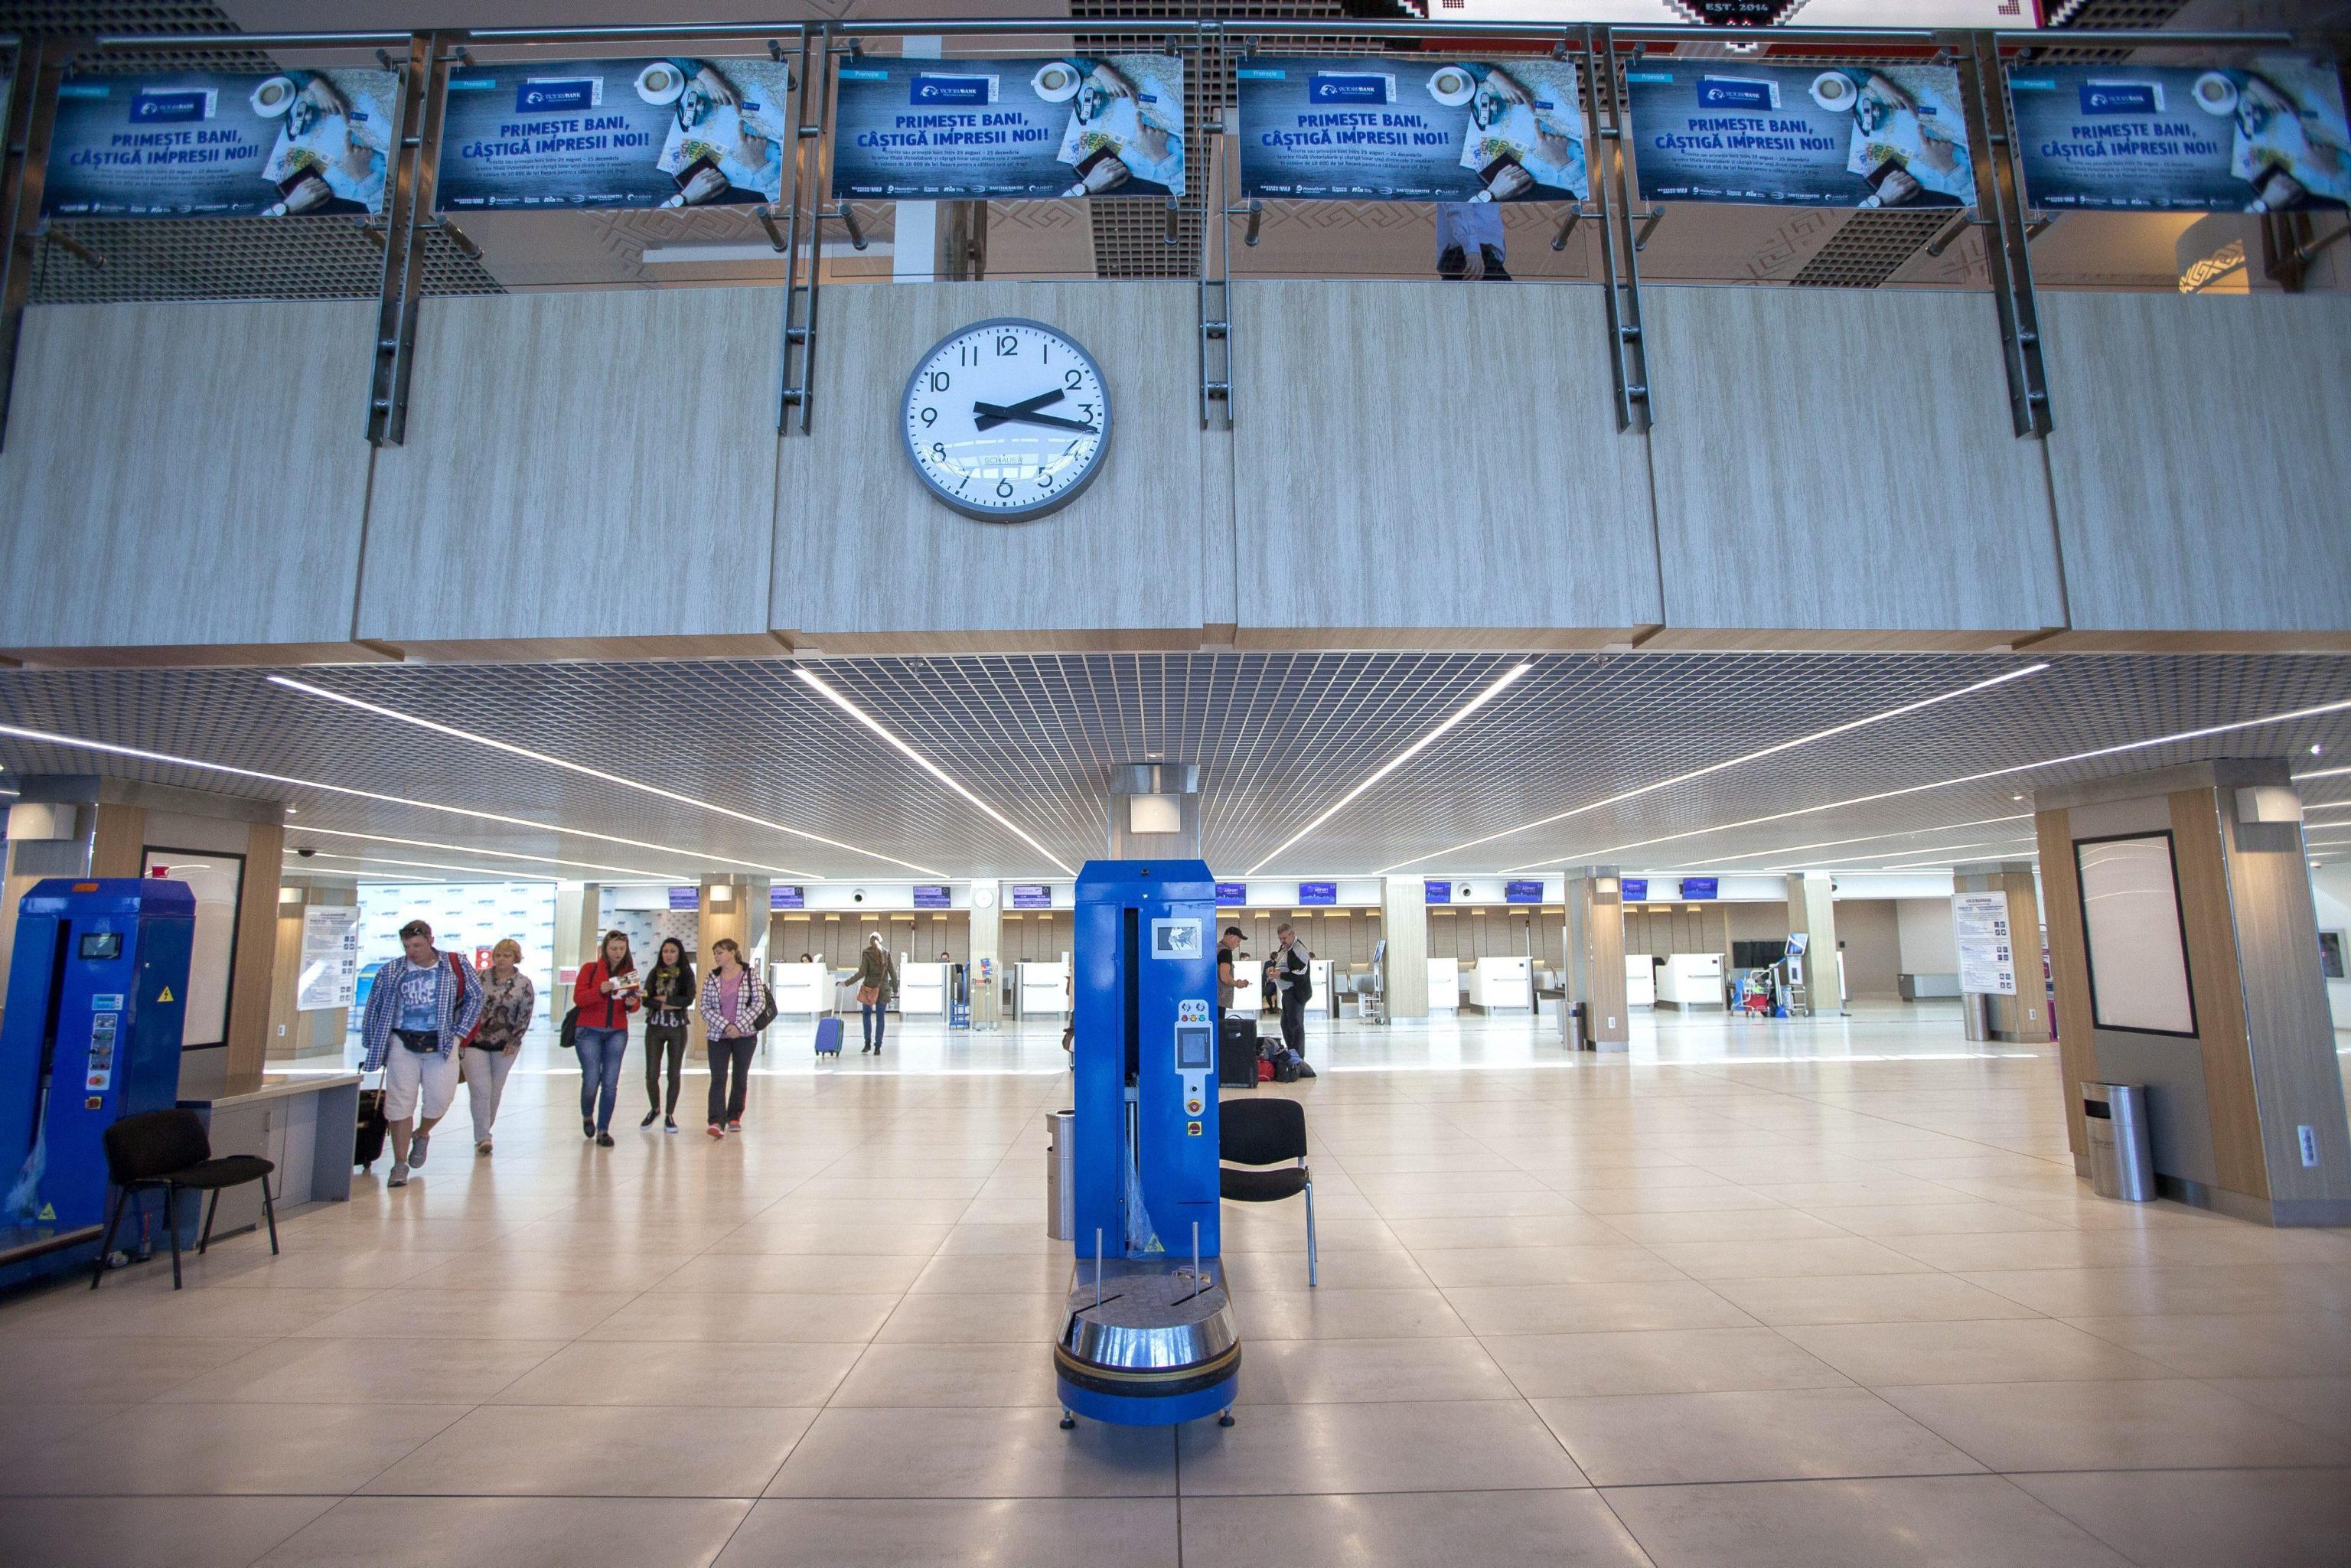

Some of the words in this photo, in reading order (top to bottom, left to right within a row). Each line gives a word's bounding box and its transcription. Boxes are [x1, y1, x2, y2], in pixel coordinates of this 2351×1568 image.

[1705, 3, 1735, 11] EST.
[584, 116, 630, 131] BANI,
[983, 112, 1029, 127] BANI,
[1383, 114, 1427, 129] BANI,
[1769, 120, 1812, 135] BANI,
[536, 136, 607, 153] IMPRESII
[613, 133, 649, 148] NOI!
[933, 131, 1006, 145] IMPRESII
[1012, 128, 1048, 142] NOI!
[1336, 131, 1407, 145] IMPRESII
[1414, 132, 1449, 145] NOI!
[1727, 136, 1795, 150] IMPRESII
[1800, 138, 1834, 150] NOI!
[147, 148, 219, 165] IMPRESII
[2111, 142, 2179, 156] IMPRESII
[996, 335, 1018, 356] 12
[1043, 344, 1048, 364] 1
[961, 346, 977, 366] 11
[931, 371, 950, 392] 10
[1065, 370, 1081, 390] 2
[921, 407, 937, 428] 9
[1078, 404, 1094, 425] 3
[931, 442, 946, 464] 8
[984, 456, 1023, 465] SCHAUER
[958, 468, 973, 489] 7
[1038, 467, 1053, 488] 5
[996, 478, 1013, 498] 6
